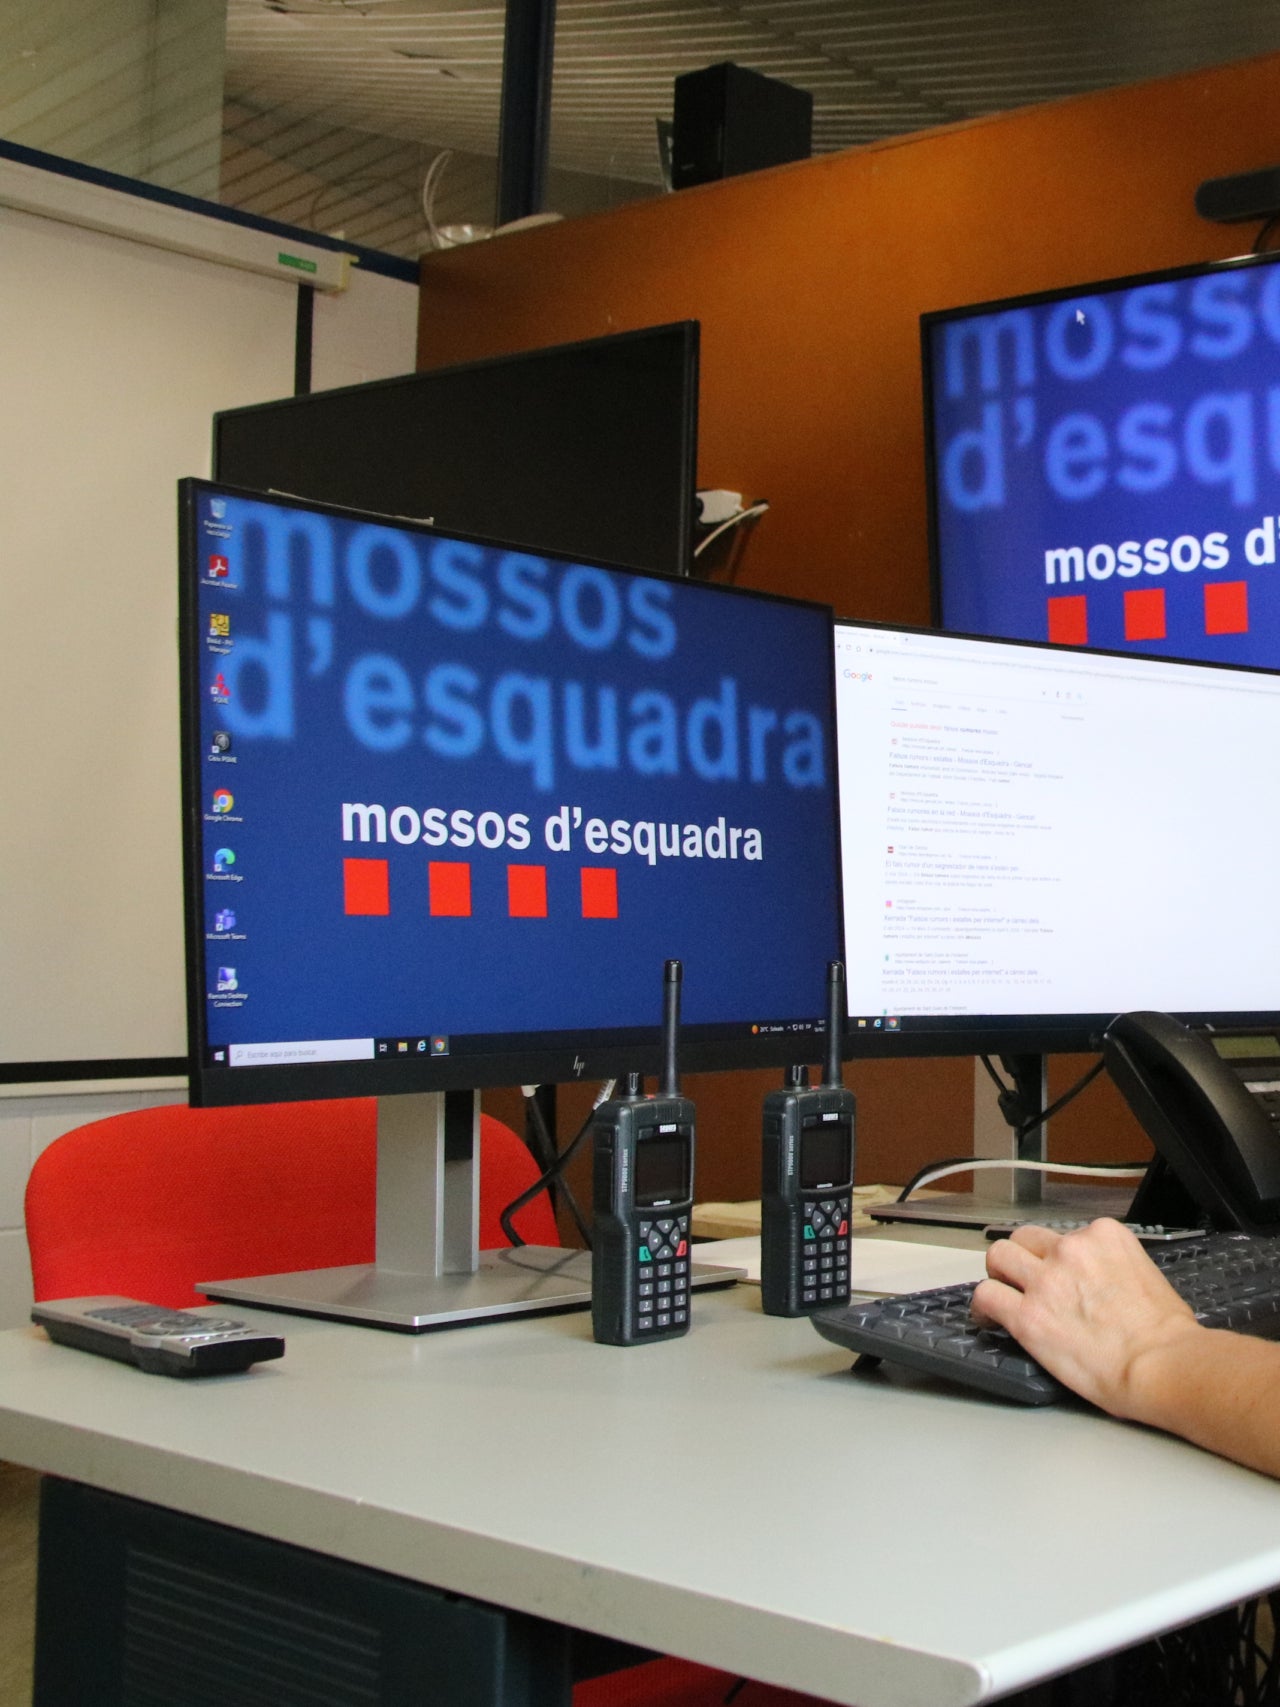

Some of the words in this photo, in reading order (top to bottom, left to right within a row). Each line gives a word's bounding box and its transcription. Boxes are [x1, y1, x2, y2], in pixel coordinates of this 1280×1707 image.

[1045, 532, 1229, 584] mossos
[222, 500, 679, 661] mossos
[842, 667, 873, 681] Google
[211, 608, 830, 797] d'esquadra
[204, 814, 221, 823] Google
[222, 815, 243, 823] Chrome
[343, 803, 530, 850] mossos
[545, 806, 762, 865] d'esquadra
[206, 873, 230, 881] Microsoft
[230, 873, 244, 883] Edge
[206, 933, 230, 941] Microsoft
[230, 932, 246, 941] Teams
